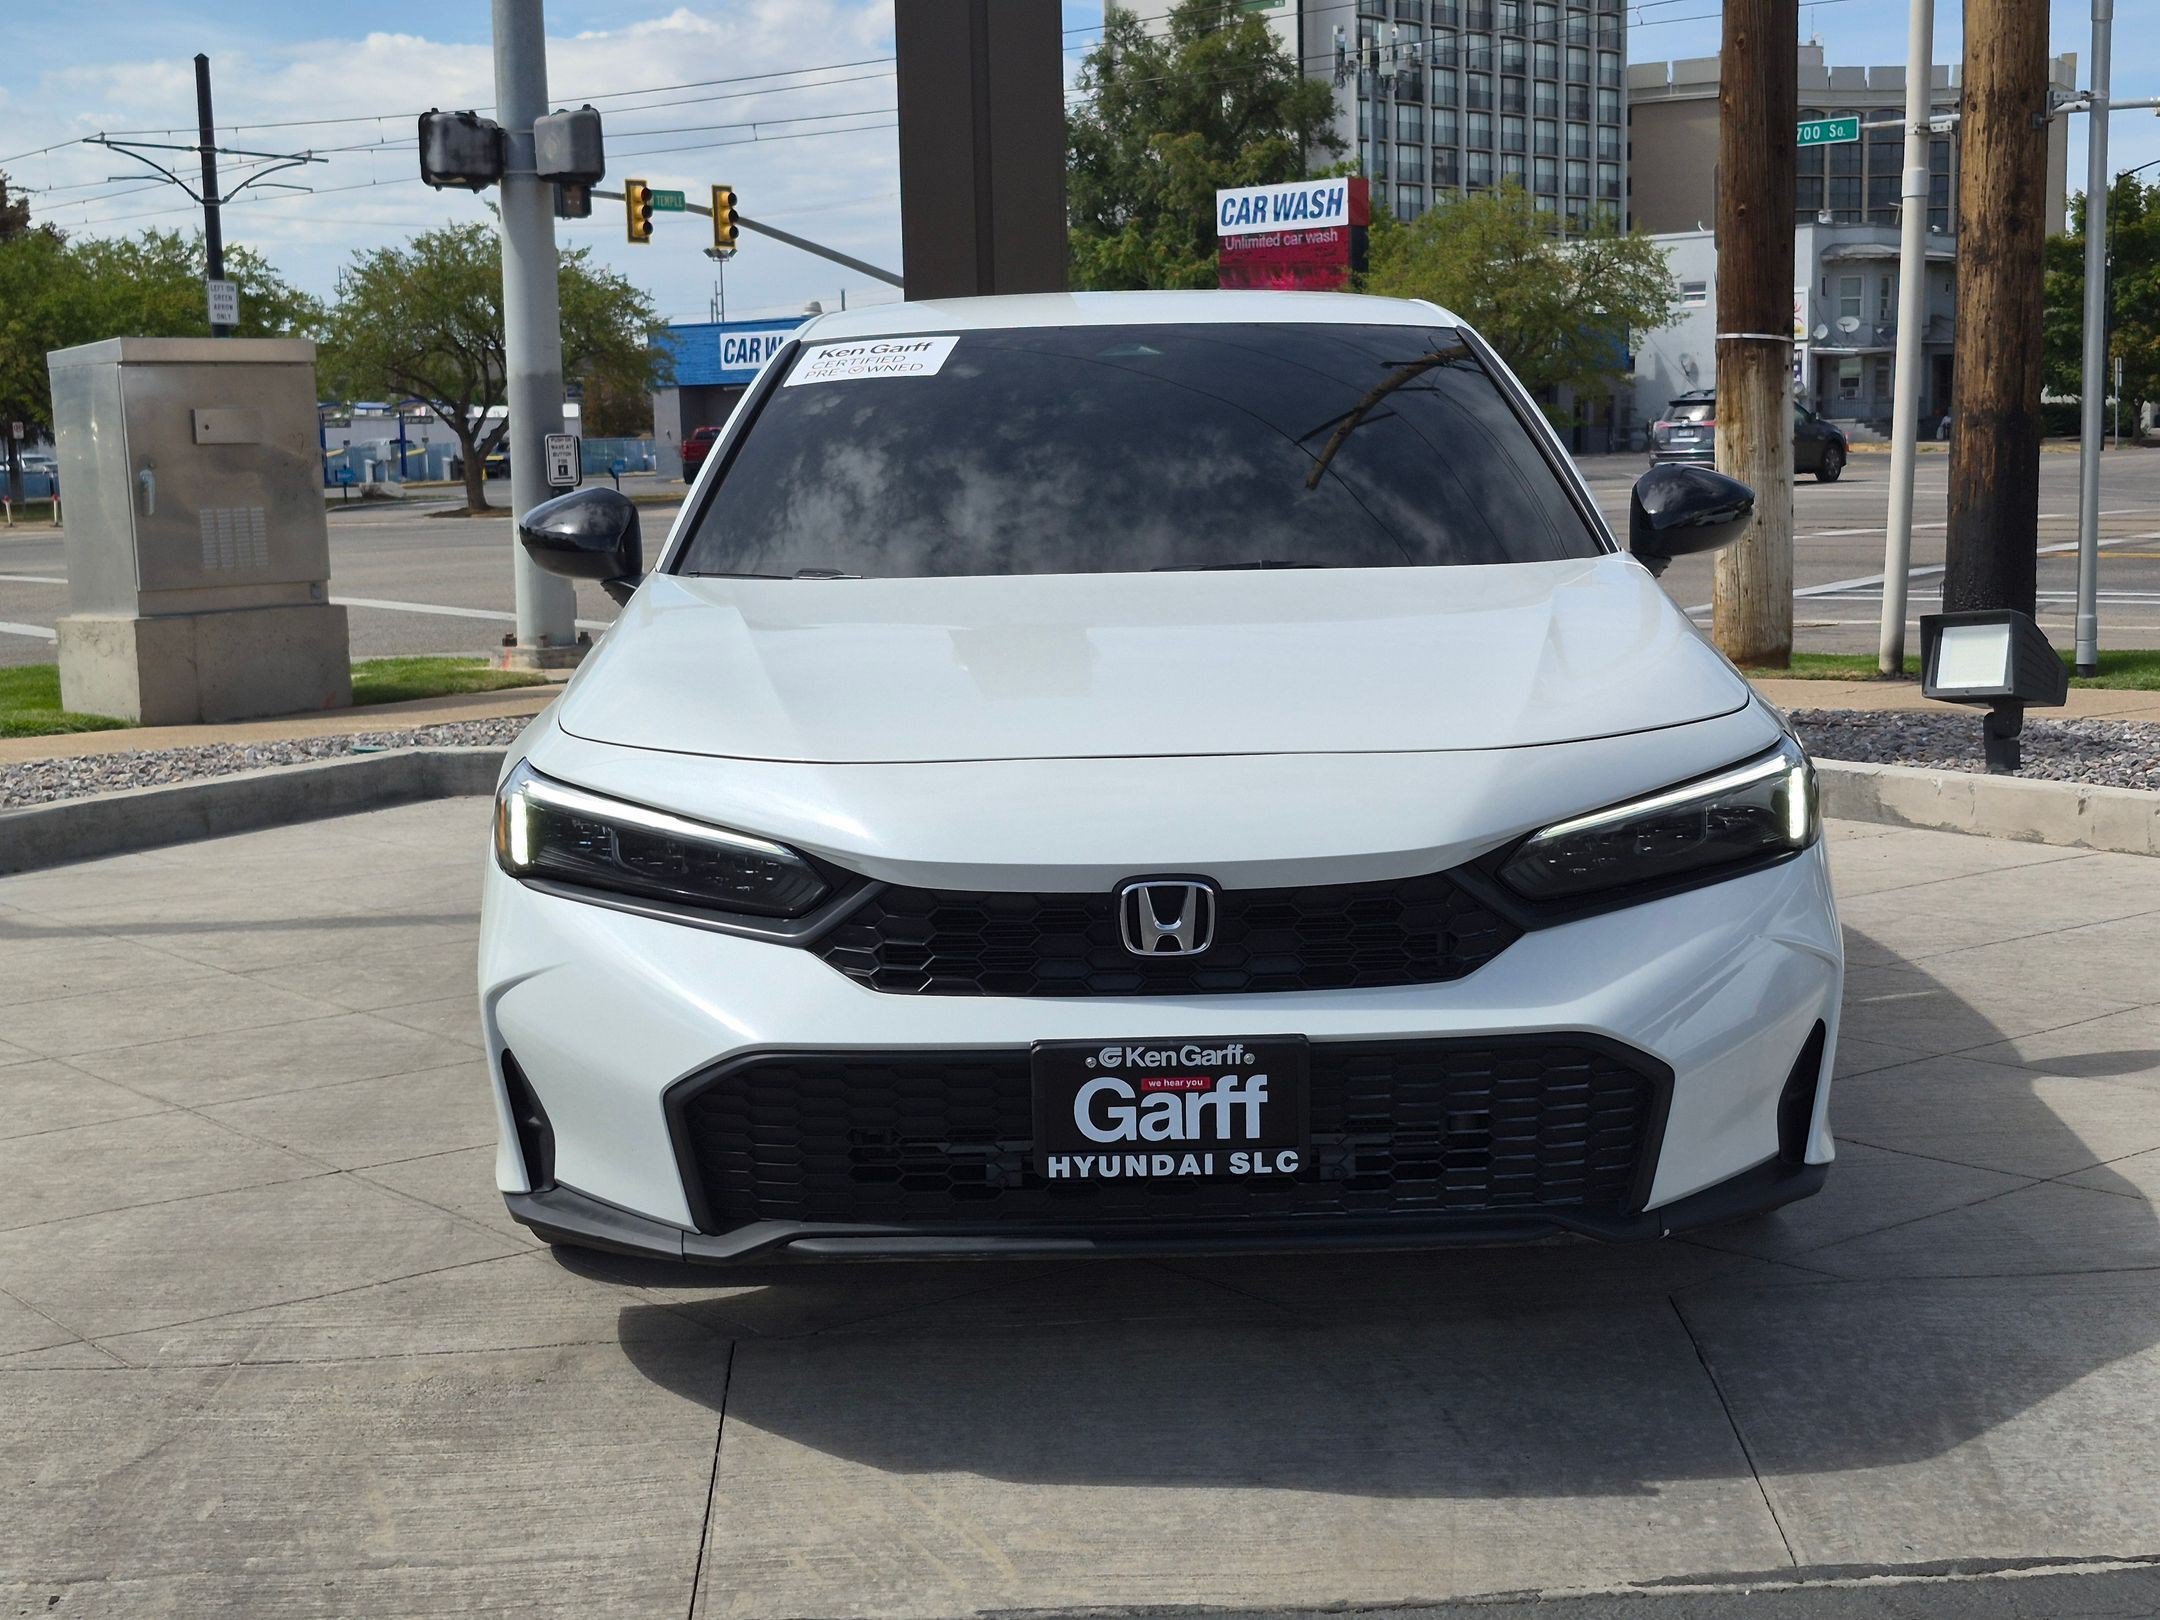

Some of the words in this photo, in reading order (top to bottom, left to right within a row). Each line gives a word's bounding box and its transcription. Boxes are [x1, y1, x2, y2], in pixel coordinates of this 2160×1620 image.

[1828, 123, 1846, 138] So.
[656, 195, 683, 208] TEMPLE
[1220, 195, 1269, 226] CAR
[1273, 187, 1344, 222] WASH
[1225, 234, 1280, 250] Unlimited
[1283, 233, 1302, 246] car
[1305, 230, 1338, 244] wash
[213, 303, 233, 311] ARROW
[216, 312, 231, 320] ONLY
[723, 337, 762, 364] CAR
[818, 347, 865, 359] Ken
[870, 341, 933, 355] Garff
[811, 355, 906, 370] CERTIFIED
[1125, 1046, 1177, 1068] Ken
[1180, 1044, 1243, 1066] Garff
[1148, 1080, 1162, 1088] we
[1164, 1078, 1184, 1087] hear
[1186, 1078, 1203, 1088] you
[1073, 1074, 1268, 1143] Garff
[1048, 1153, 1213, 1178] HYUNDAI
[1229, 1151, 1299, 1174] SLC
